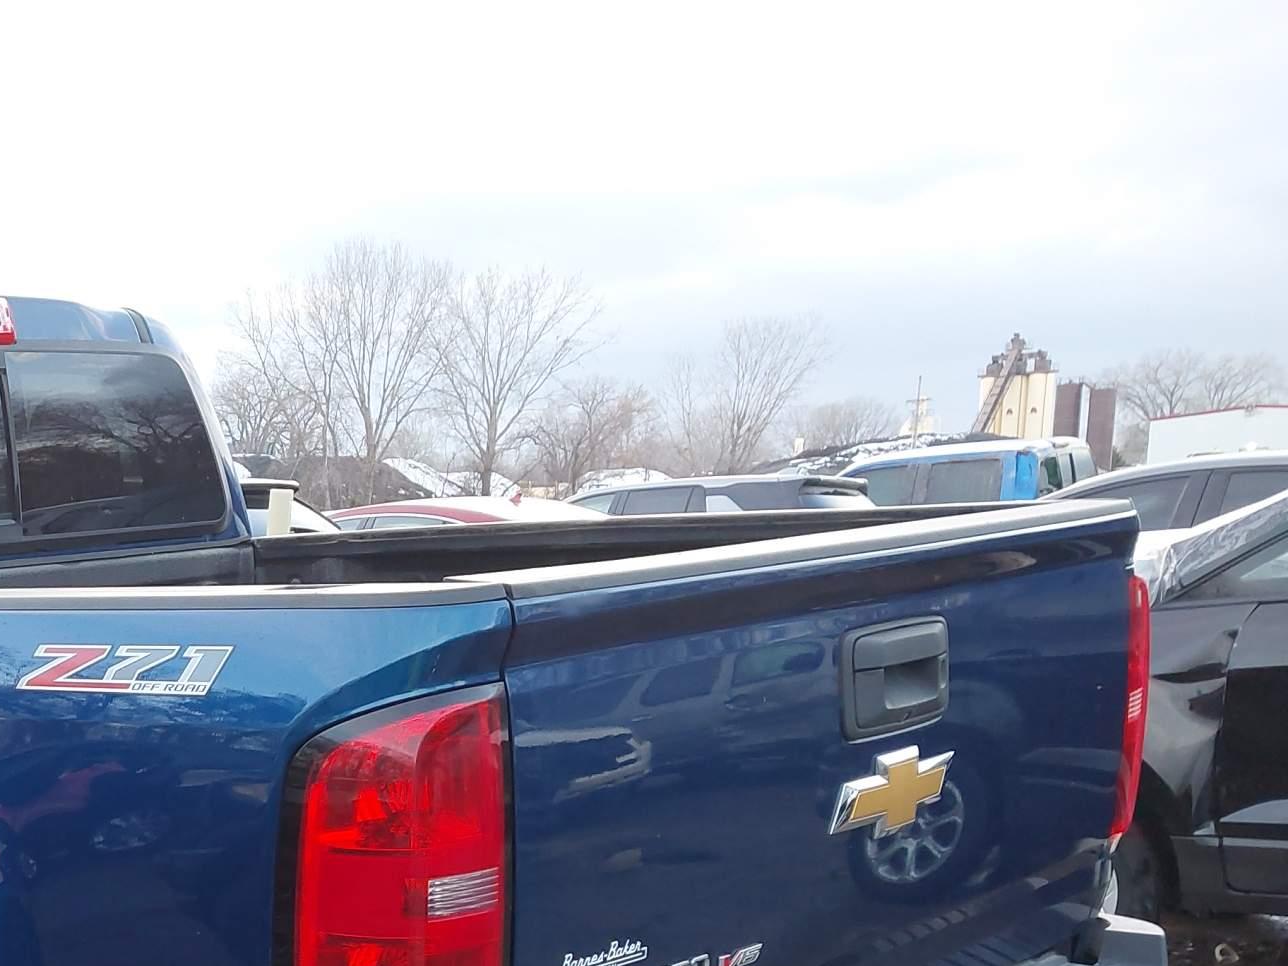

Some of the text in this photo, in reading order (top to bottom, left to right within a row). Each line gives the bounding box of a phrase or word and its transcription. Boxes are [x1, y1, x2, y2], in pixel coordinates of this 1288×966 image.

[16, 644, 234, 692] Z71
[131, 682, 208, 693] OFF ROAD
